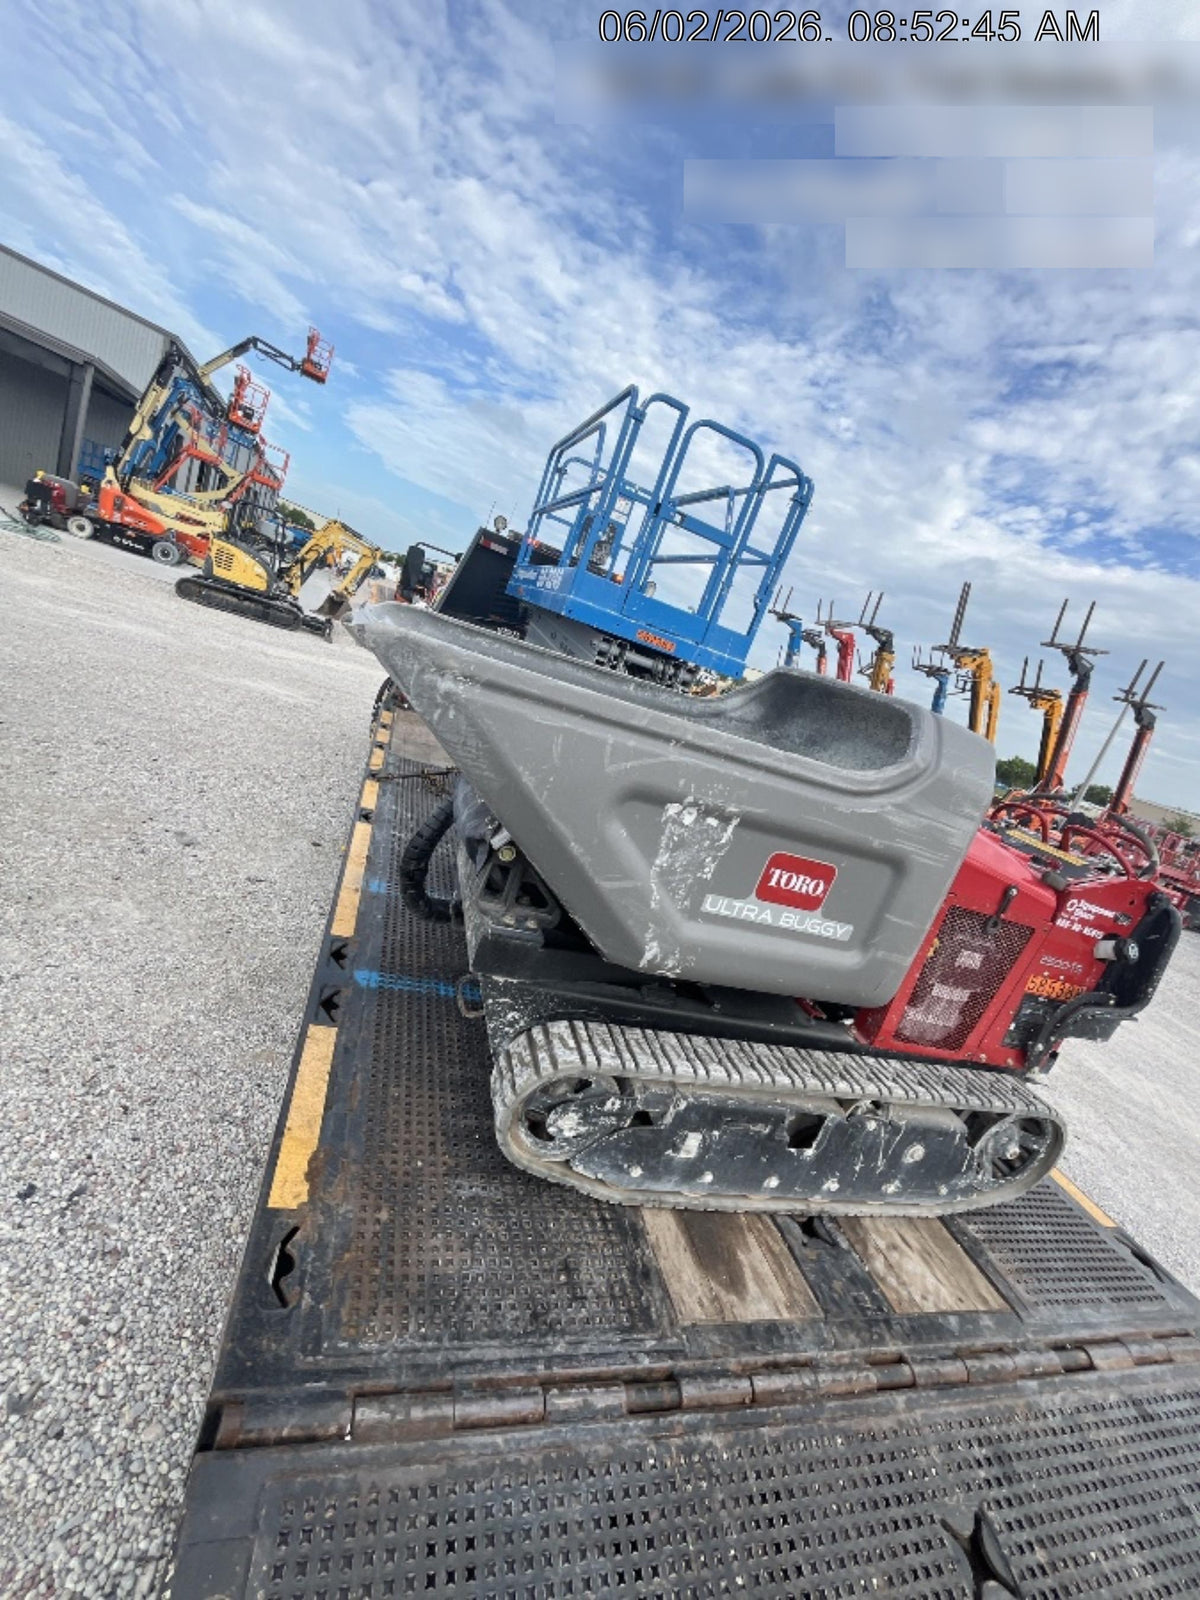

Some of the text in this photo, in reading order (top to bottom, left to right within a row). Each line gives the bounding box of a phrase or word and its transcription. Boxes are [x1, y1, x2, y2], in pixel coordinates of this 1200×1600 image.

[768, 867, 824, 898] TORO
[705, 895, 850, 938] ULTRA BUGGY
